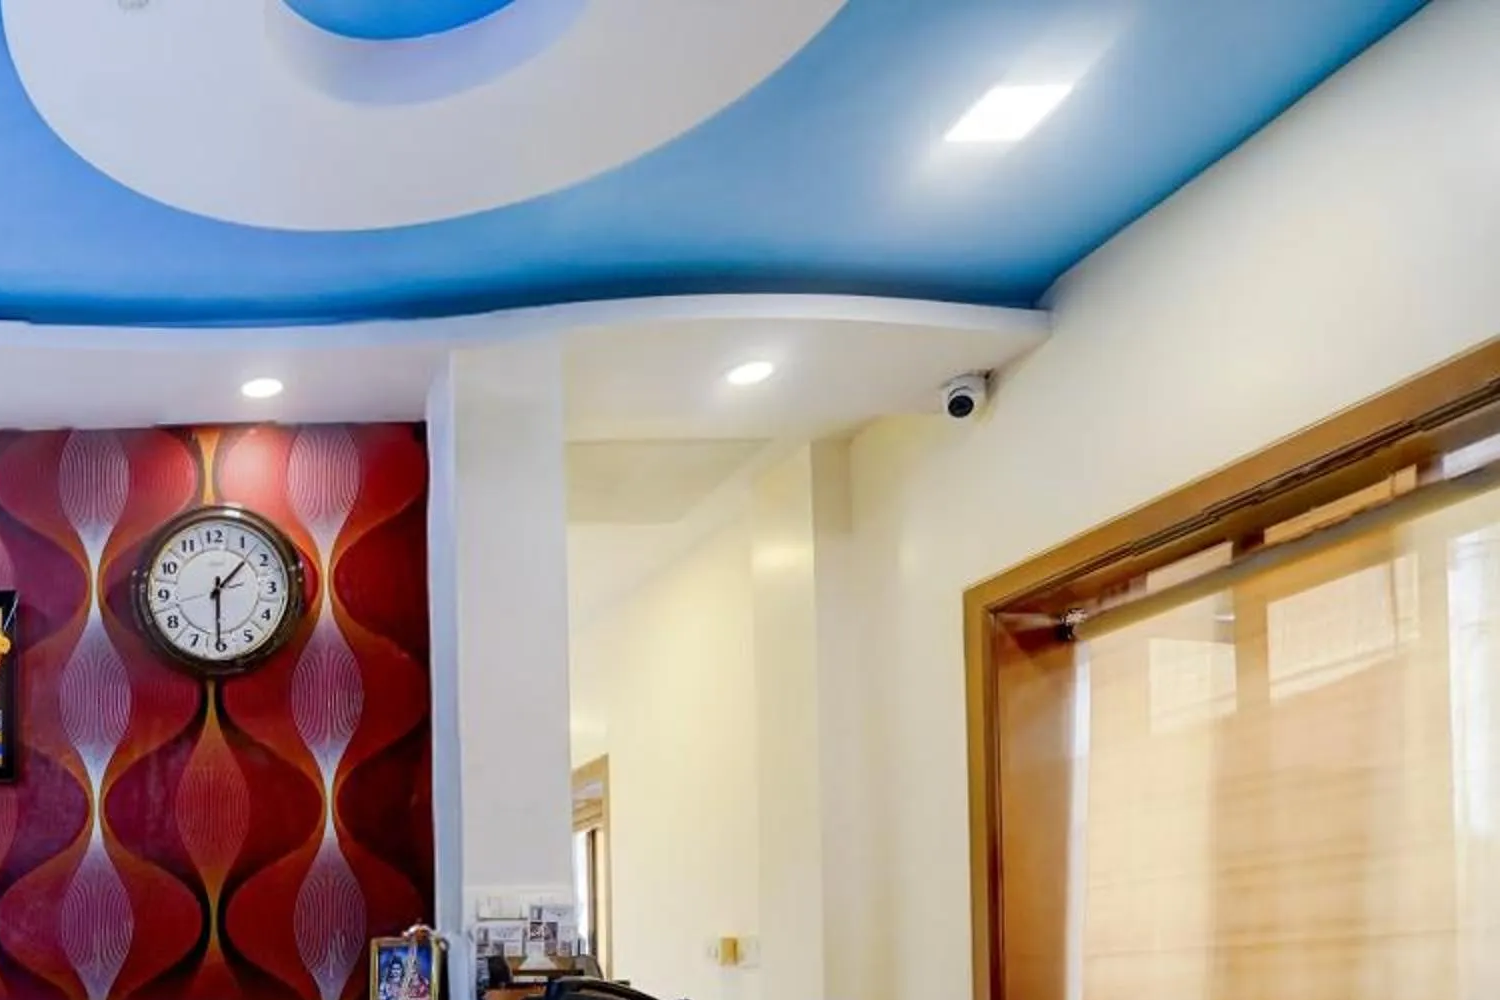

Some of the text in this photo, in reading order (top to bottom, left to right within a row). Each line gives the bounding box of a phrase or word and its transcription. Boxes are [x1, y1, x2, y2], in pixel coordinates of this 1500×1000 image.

[205, 529, 223, 543] 12
[239, 535, 245, 549] 1
[181, 539, 195, 552] 11
[259, 553, 269, 567] 2
[161, 561, 178, 575] 10
[157, 588, 170, 599] 9
[267, 581, 277, 595] 3
[261, 608, 272, 621] 4
[167, 615, 179, 629] 8
[190, 633, 200, 647] 7
[243, 629, 254, 643] 5
[214, 638, 227, 652] 6
